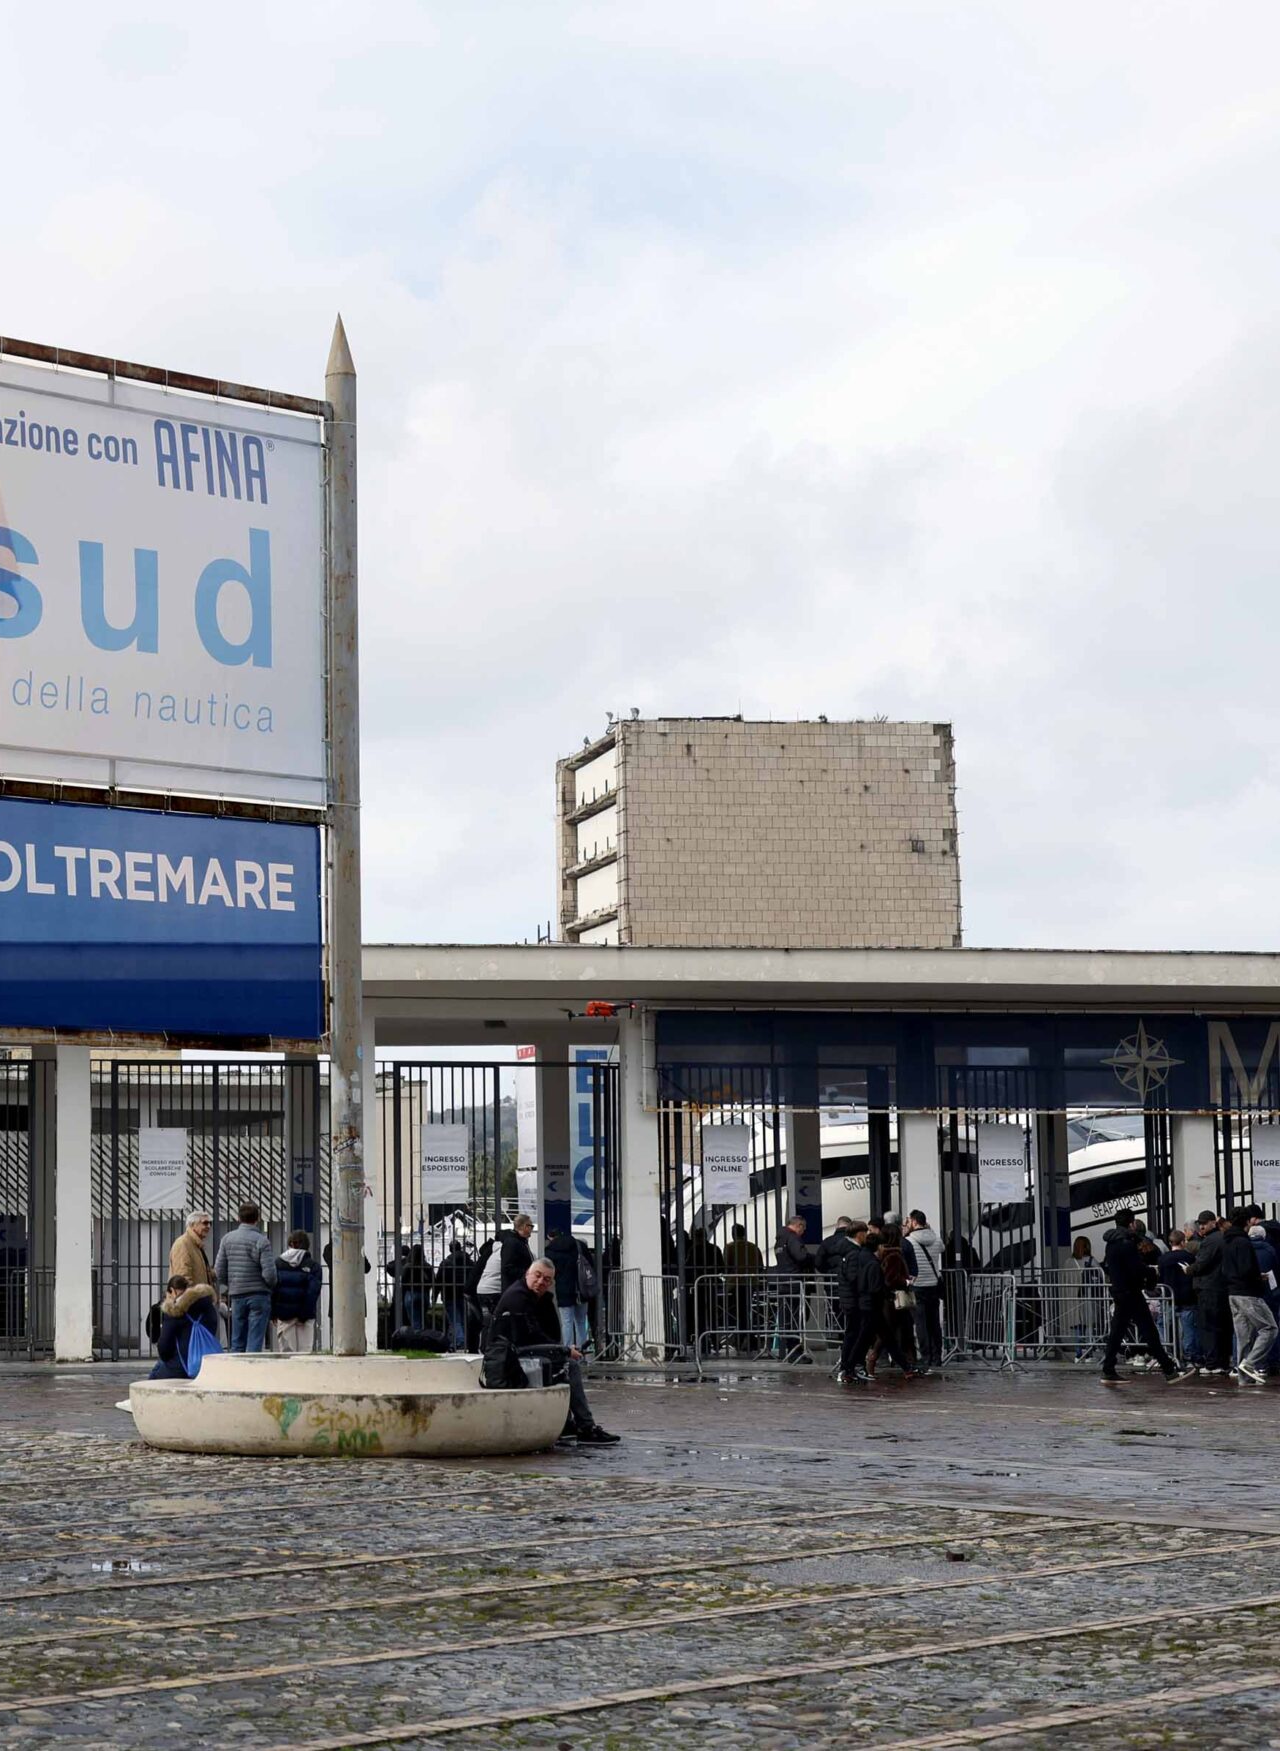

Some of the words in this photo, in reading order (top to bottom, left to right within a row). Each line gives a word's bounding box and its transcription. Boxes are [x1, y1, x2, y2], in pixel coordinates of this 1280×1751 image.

[88, 434, 138, 465] con
[12, 670, 109, 715] della
[134, 687, 275, 734] nautica
[425, 1155, 466, 1163] INGRESSO
[705, 1155, 748, 1163] INGRESSO
[980, 1158, 1024, 1167] INGRESSO
[422, 1164, 468, 1172] ESPOSITORI
[710, 1165, 743, 1173] ONLINE
